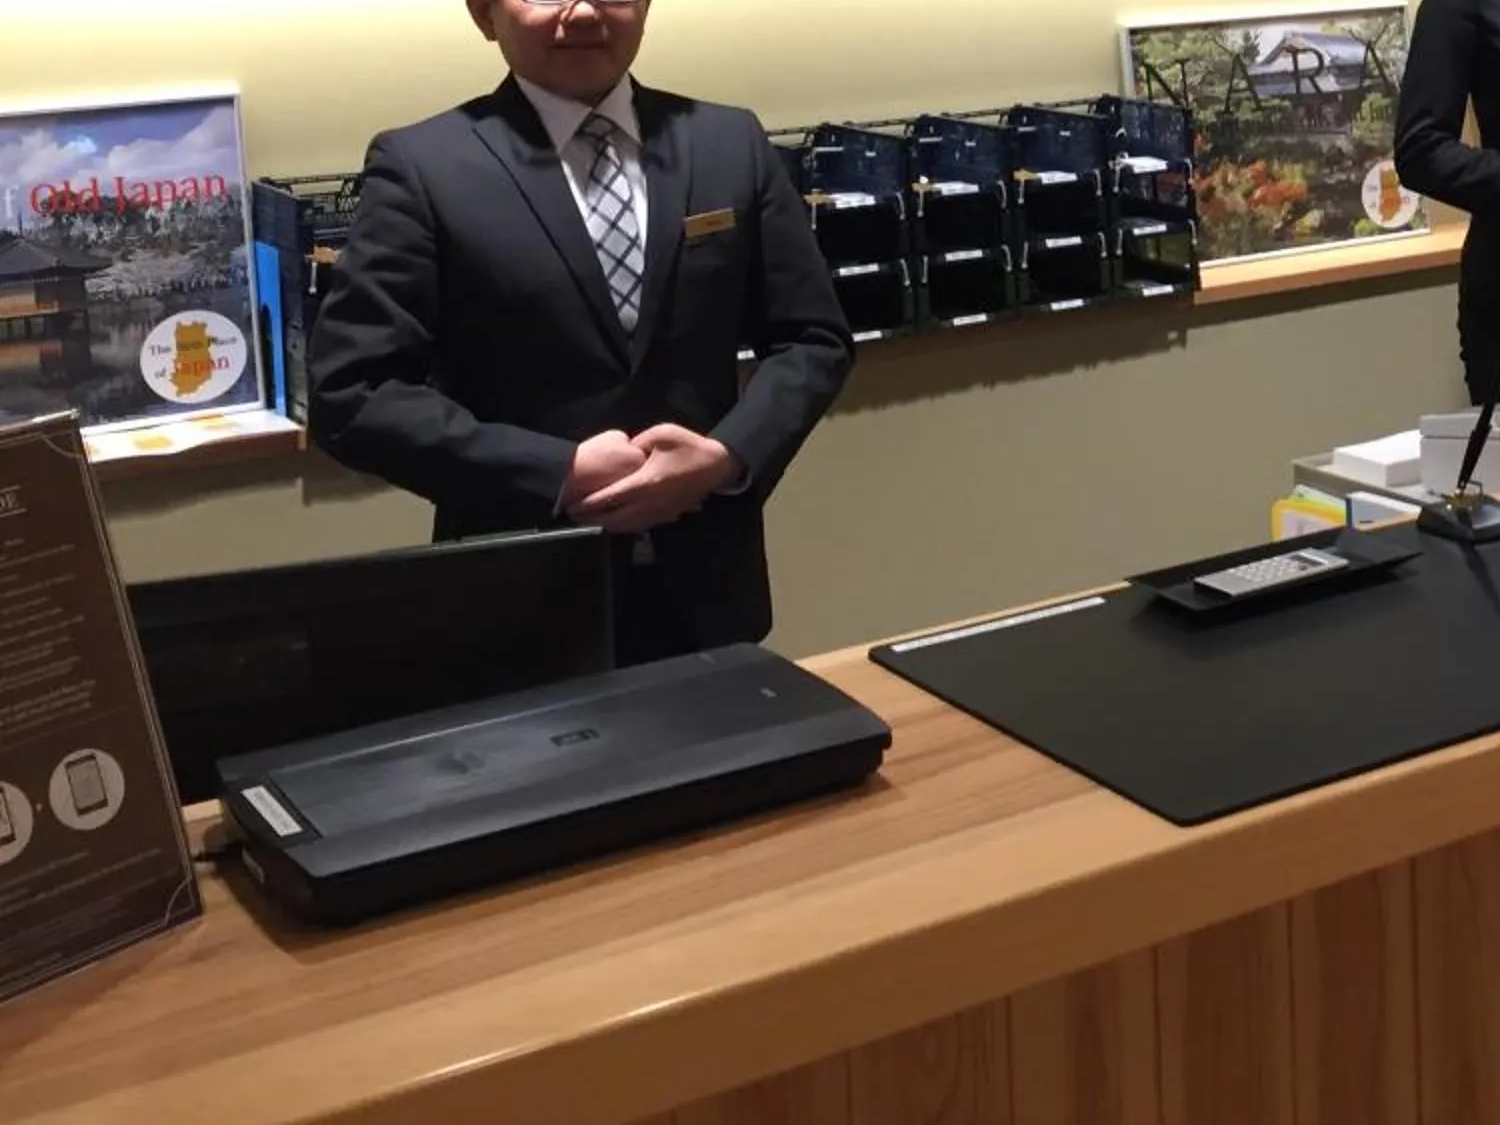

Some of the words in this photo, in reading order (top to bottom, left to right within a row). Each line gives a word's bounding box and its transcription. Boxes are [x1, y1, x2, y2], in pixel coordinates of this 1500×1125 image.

[30, 177, 103, 218] Old
[114, 173, 226, 218] Japan
[171, 355, 231, 378] Japan
